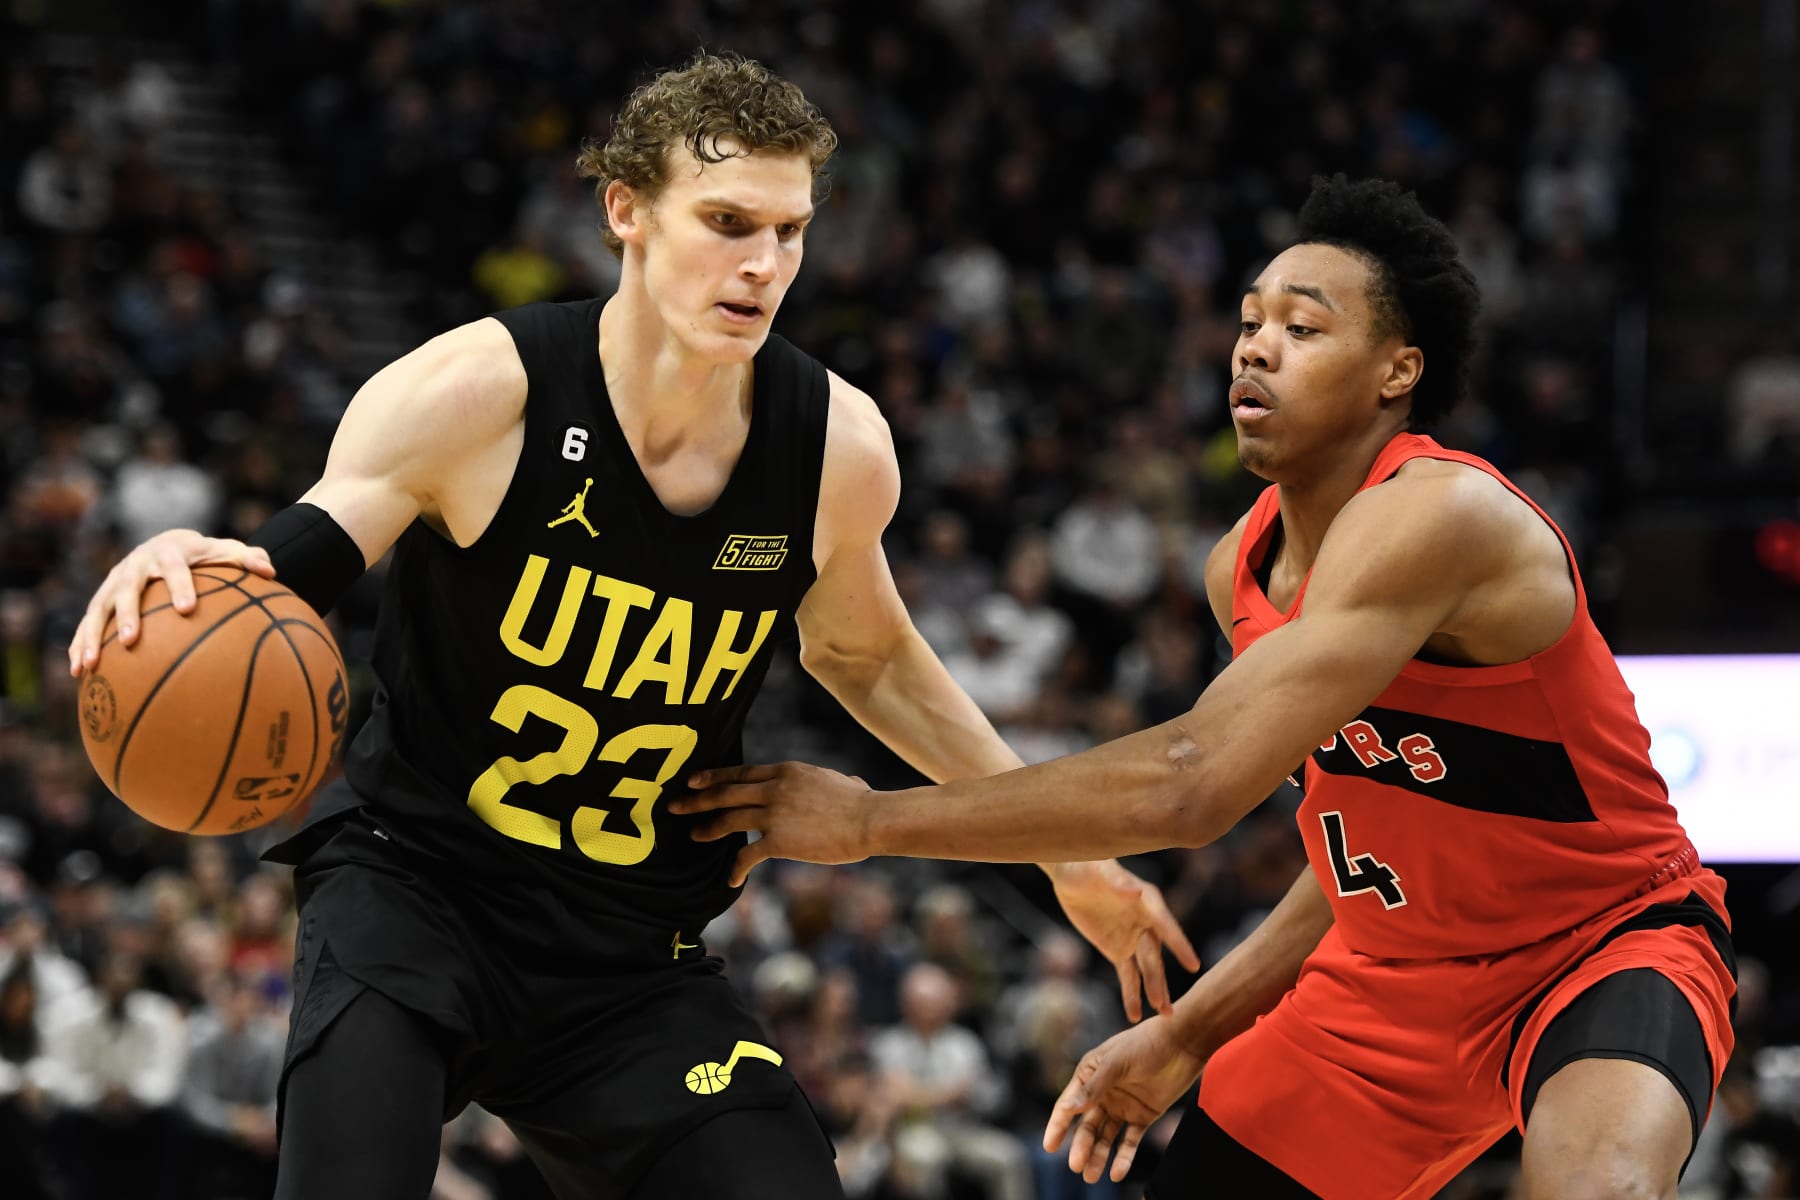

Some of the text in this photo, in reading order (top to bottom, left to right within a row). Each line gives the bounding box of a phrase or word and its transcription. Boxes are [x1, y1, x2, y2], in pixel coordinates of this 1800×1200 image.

[562, 427, 588, 461] 6
[721, 540, 745, 565] 5
[741, 554, 781, 566] FIGHT
[752, 541, 781, 549] FOR THE
[500, 554, 778, 704] UTAH
[467, 685, 698, 865] 23
[1319, 811, 1407, 910] 4
